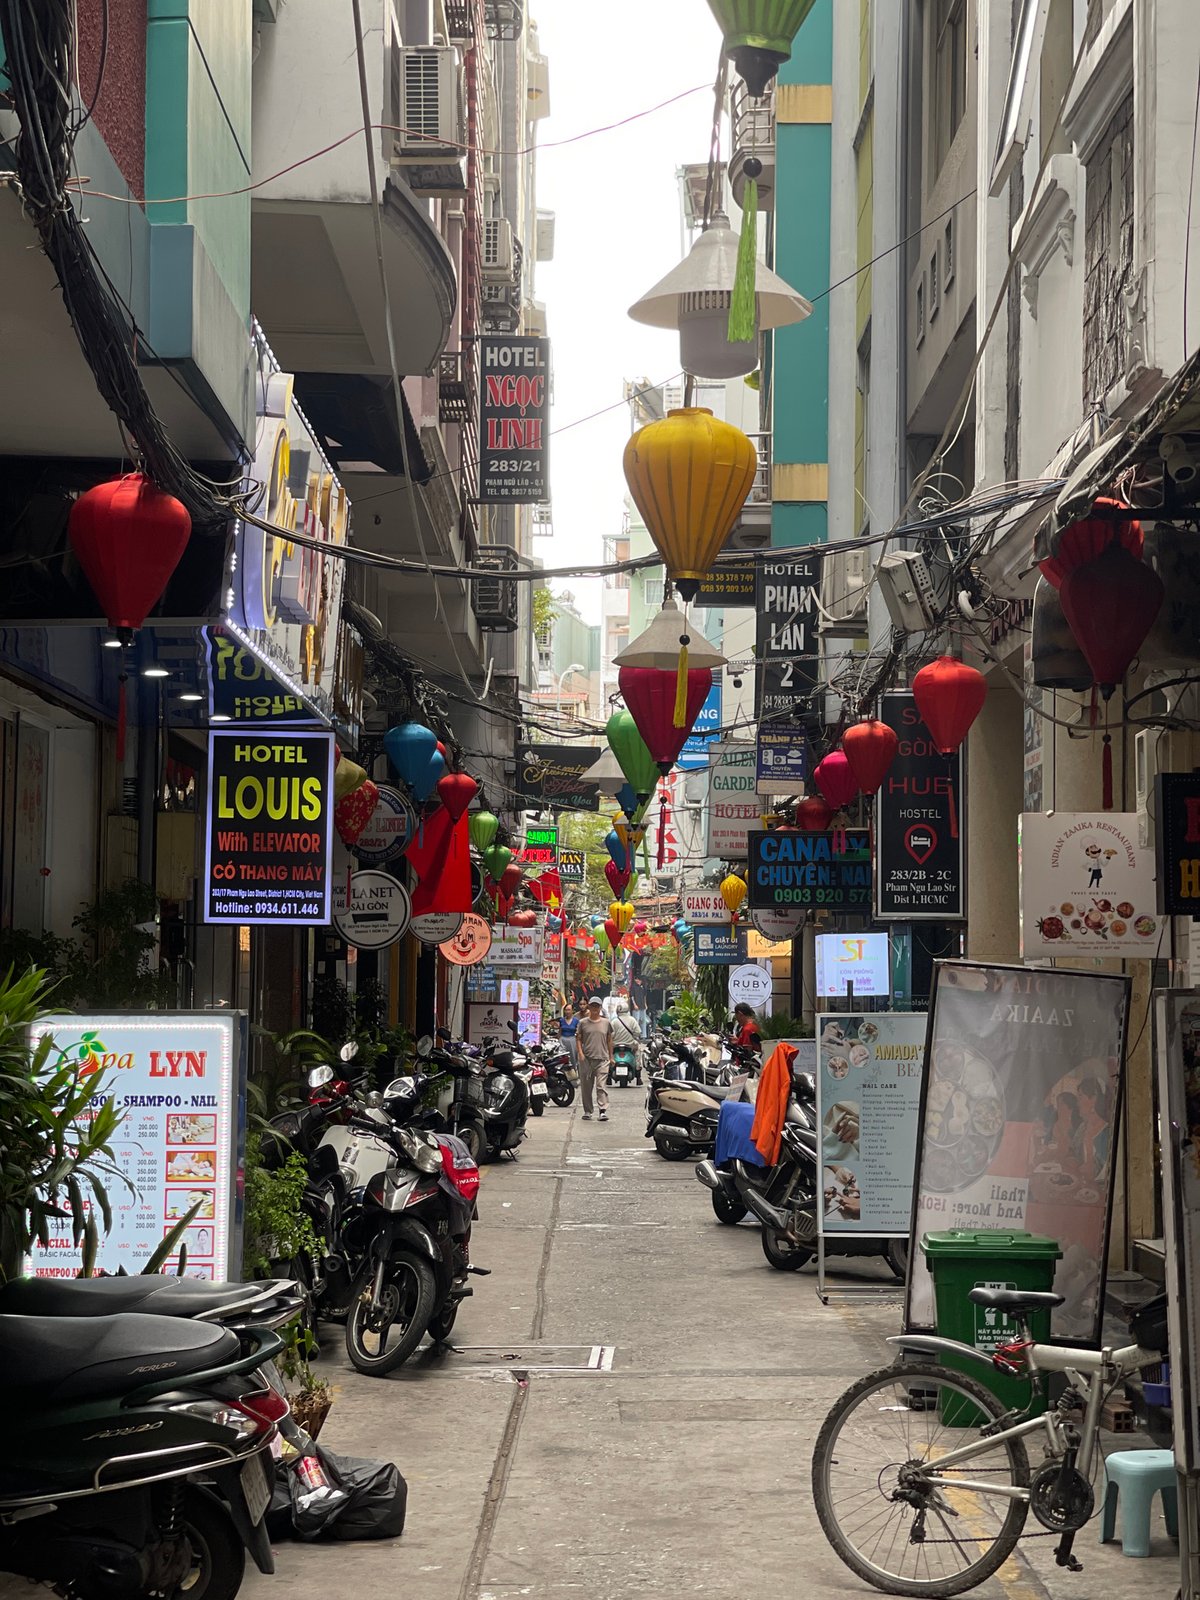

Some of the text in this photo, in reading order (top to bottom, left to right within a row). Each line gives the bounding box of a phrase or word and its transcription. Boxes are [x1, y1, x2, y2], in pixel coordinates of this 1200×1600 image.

[485, 346, 545, 367] HOTEL
[485, 375, 545, 416] NGỌC
[487, 418, 542, 450] LINH
[489, 460, 540, 472] 283/21
[764, 564, 813, 576] HOTEL
[700, 584, 714, 592] 028
[764, 585, 812, 613] PHAN
[770, 623, 805, 651] LAN
[780, 662, 794, 688] 2
[234, 744, 308, 764] HOTEL
[713, 776, 755, 791] GARDE
[217, 774, 322, 822] LOUIS
[571, 795, 593, 805] You
[715, 804, 761, 819] HOTEL
[899, 808, 942, 819] HOSTEL
[376, 817, 406, 833] LINH
[217, 831, 321, 854] With ELEVATOR
[527, 830, 556, 845] GARDEN
[1051, 839, 1065, 868] INDIAN
[1063, 821, 1093, 839] ZAAIKA
[213, 860, 323, 881] CÓ THANG MÁY
[757, 862, 836, 887] CHUYÊN:
[890, 870, 952, 880] 283/2B 2C
[352, 886, 395, 899] LANET
[885, 882, 956, 893] Pham Ngu Lao Str
[686, 896, 711, 910] GIANG
[774, 888, 811, 904] 0903
[815, 888, 843, 904] 920
[893, 894, 949, 905] Dist 1, HCMC
[215, 901, 319, 915] Hotline: 0934.611.446
[367, 901, 388, 911] GÒN
[518, 932, 532, 948] Spa
[733, 980, 769, 988] RUBY
[520, 1013, 537, 1022] SPA
[875, 1044, 927, 1060] AMADA'
[149, 1051, 207, 1077] LYN
[124, 1095, 218, 1107] SHAMPOO NAIL
[35, 1267, 71, 1278] SHAMPOO
